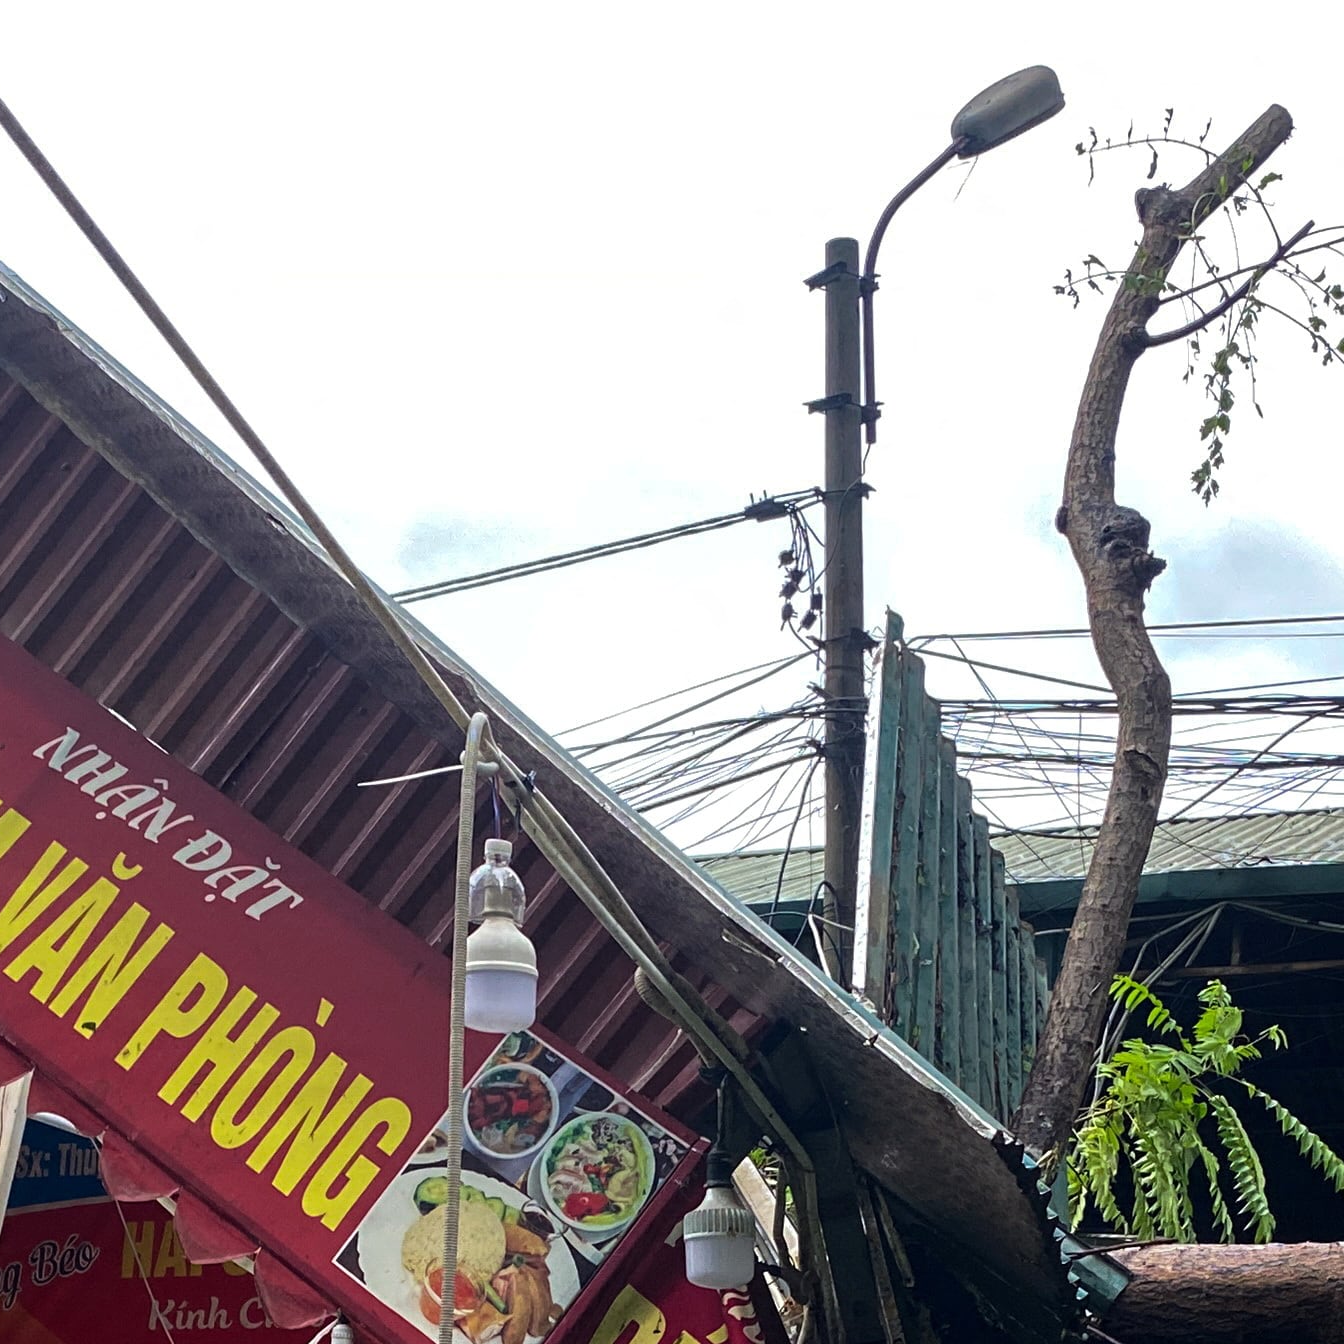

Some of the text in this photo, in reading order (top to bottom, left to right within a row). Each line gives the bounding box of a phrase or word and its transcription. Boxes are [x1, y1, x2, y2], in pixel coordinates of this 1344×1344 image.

[32, 727, 305, 922] NHẬN ĐẶT
[115, 953, 412, 1231] PHÒNG
[29, 1233, 101, 1286] Béo
[147, 1295, 233, 1332] Kính
